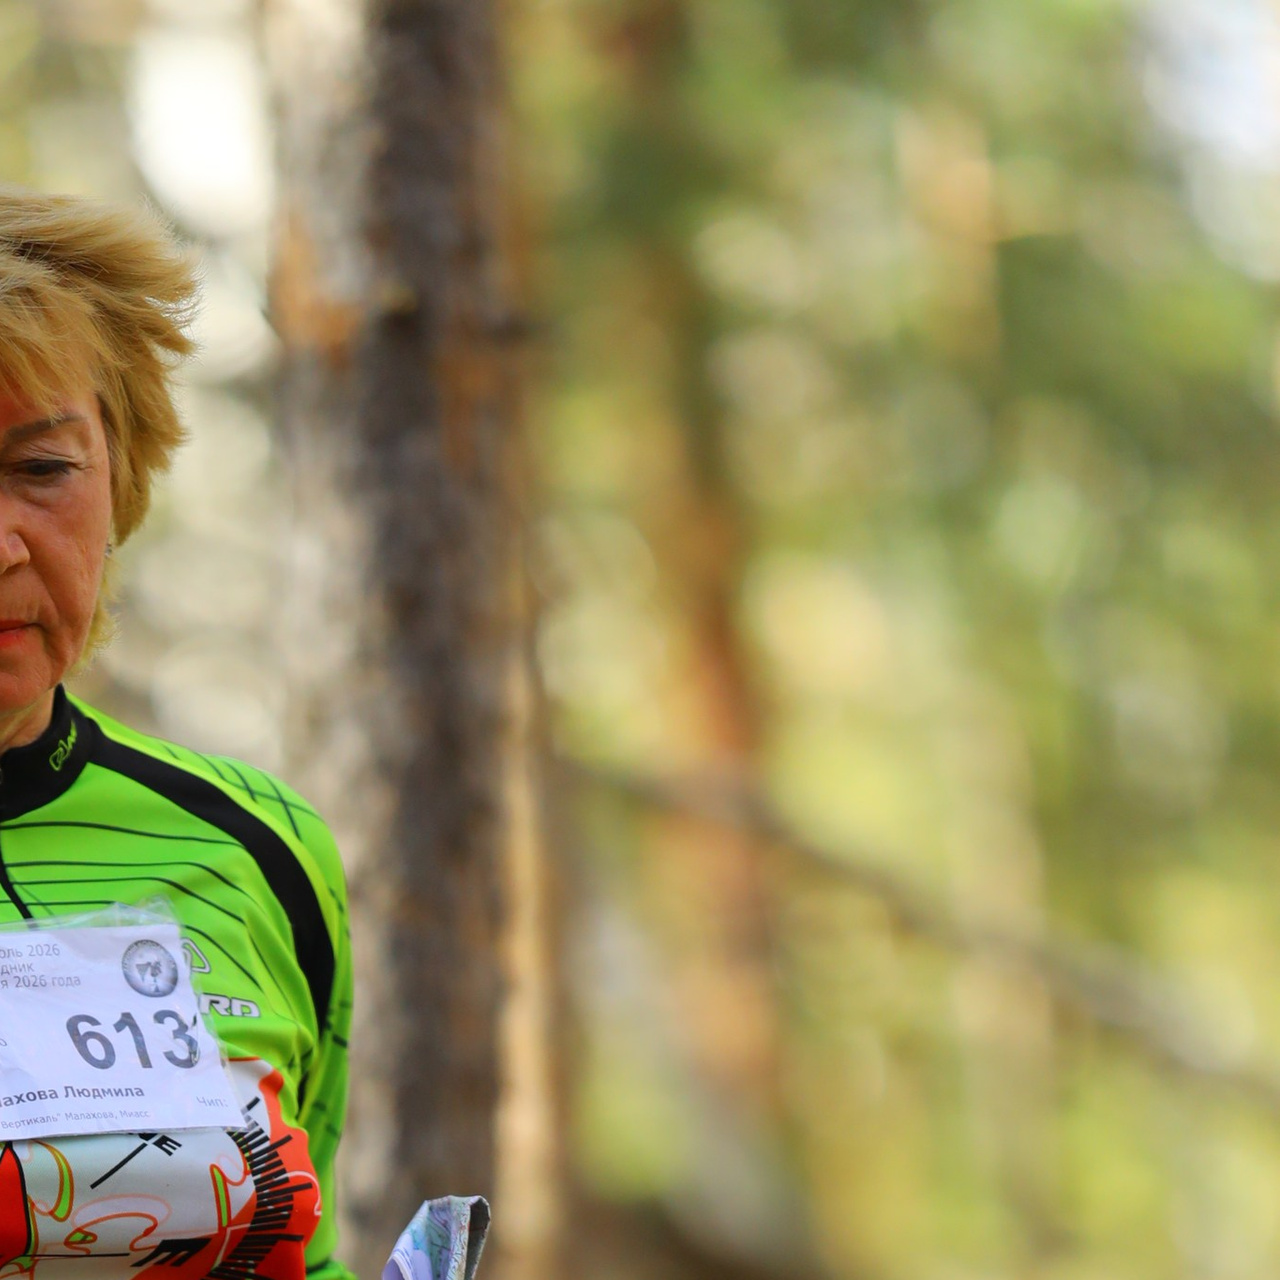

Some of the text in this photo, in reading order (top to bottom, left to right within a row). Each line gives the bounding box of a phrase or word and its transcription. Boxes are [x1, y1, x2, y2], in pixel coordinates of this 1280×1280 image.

[26, 943, 61, 957] 2026
[13, 974, 48, 988] 2026
[51, 974, 82, 988] года
[66, 1009, 200, 1070] 613
[64, 1085, 145, 1101] Людмила
[196, 1095, 229, 1109] Чип:
[65, 1110, 119, 1122] Малахова,
[119, 1109, 151, 1119] Миасс
